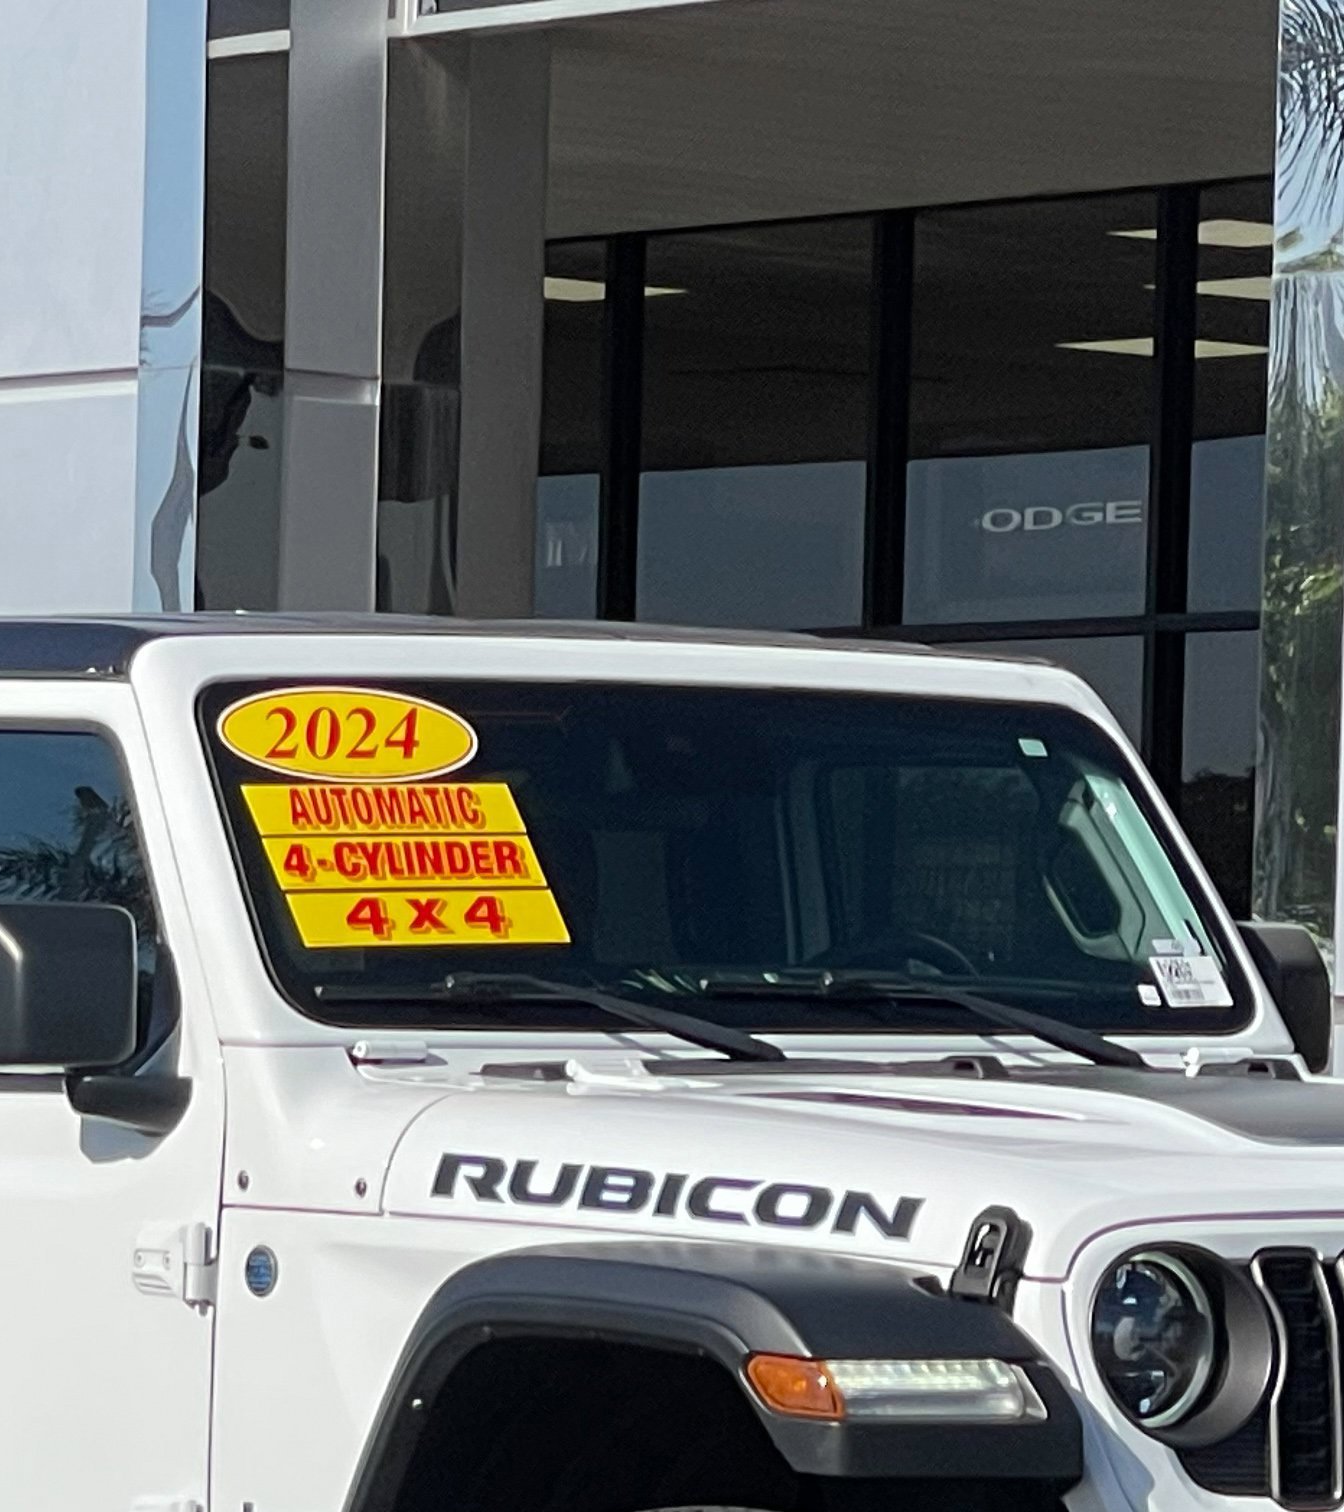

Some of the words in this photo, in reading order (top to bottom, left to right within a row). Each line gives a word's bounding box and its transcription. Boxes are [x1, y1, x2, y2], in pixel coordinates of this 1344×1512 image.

[976, 500, 1143, 533] ODGE
[264, 706, 421, 761] 2024
[289, 786, 485, 831] AUTOMATIC
[283, 841, 529, 882] 4-CYLINDER
[429, 1152, 926, 1241] RUBICON
